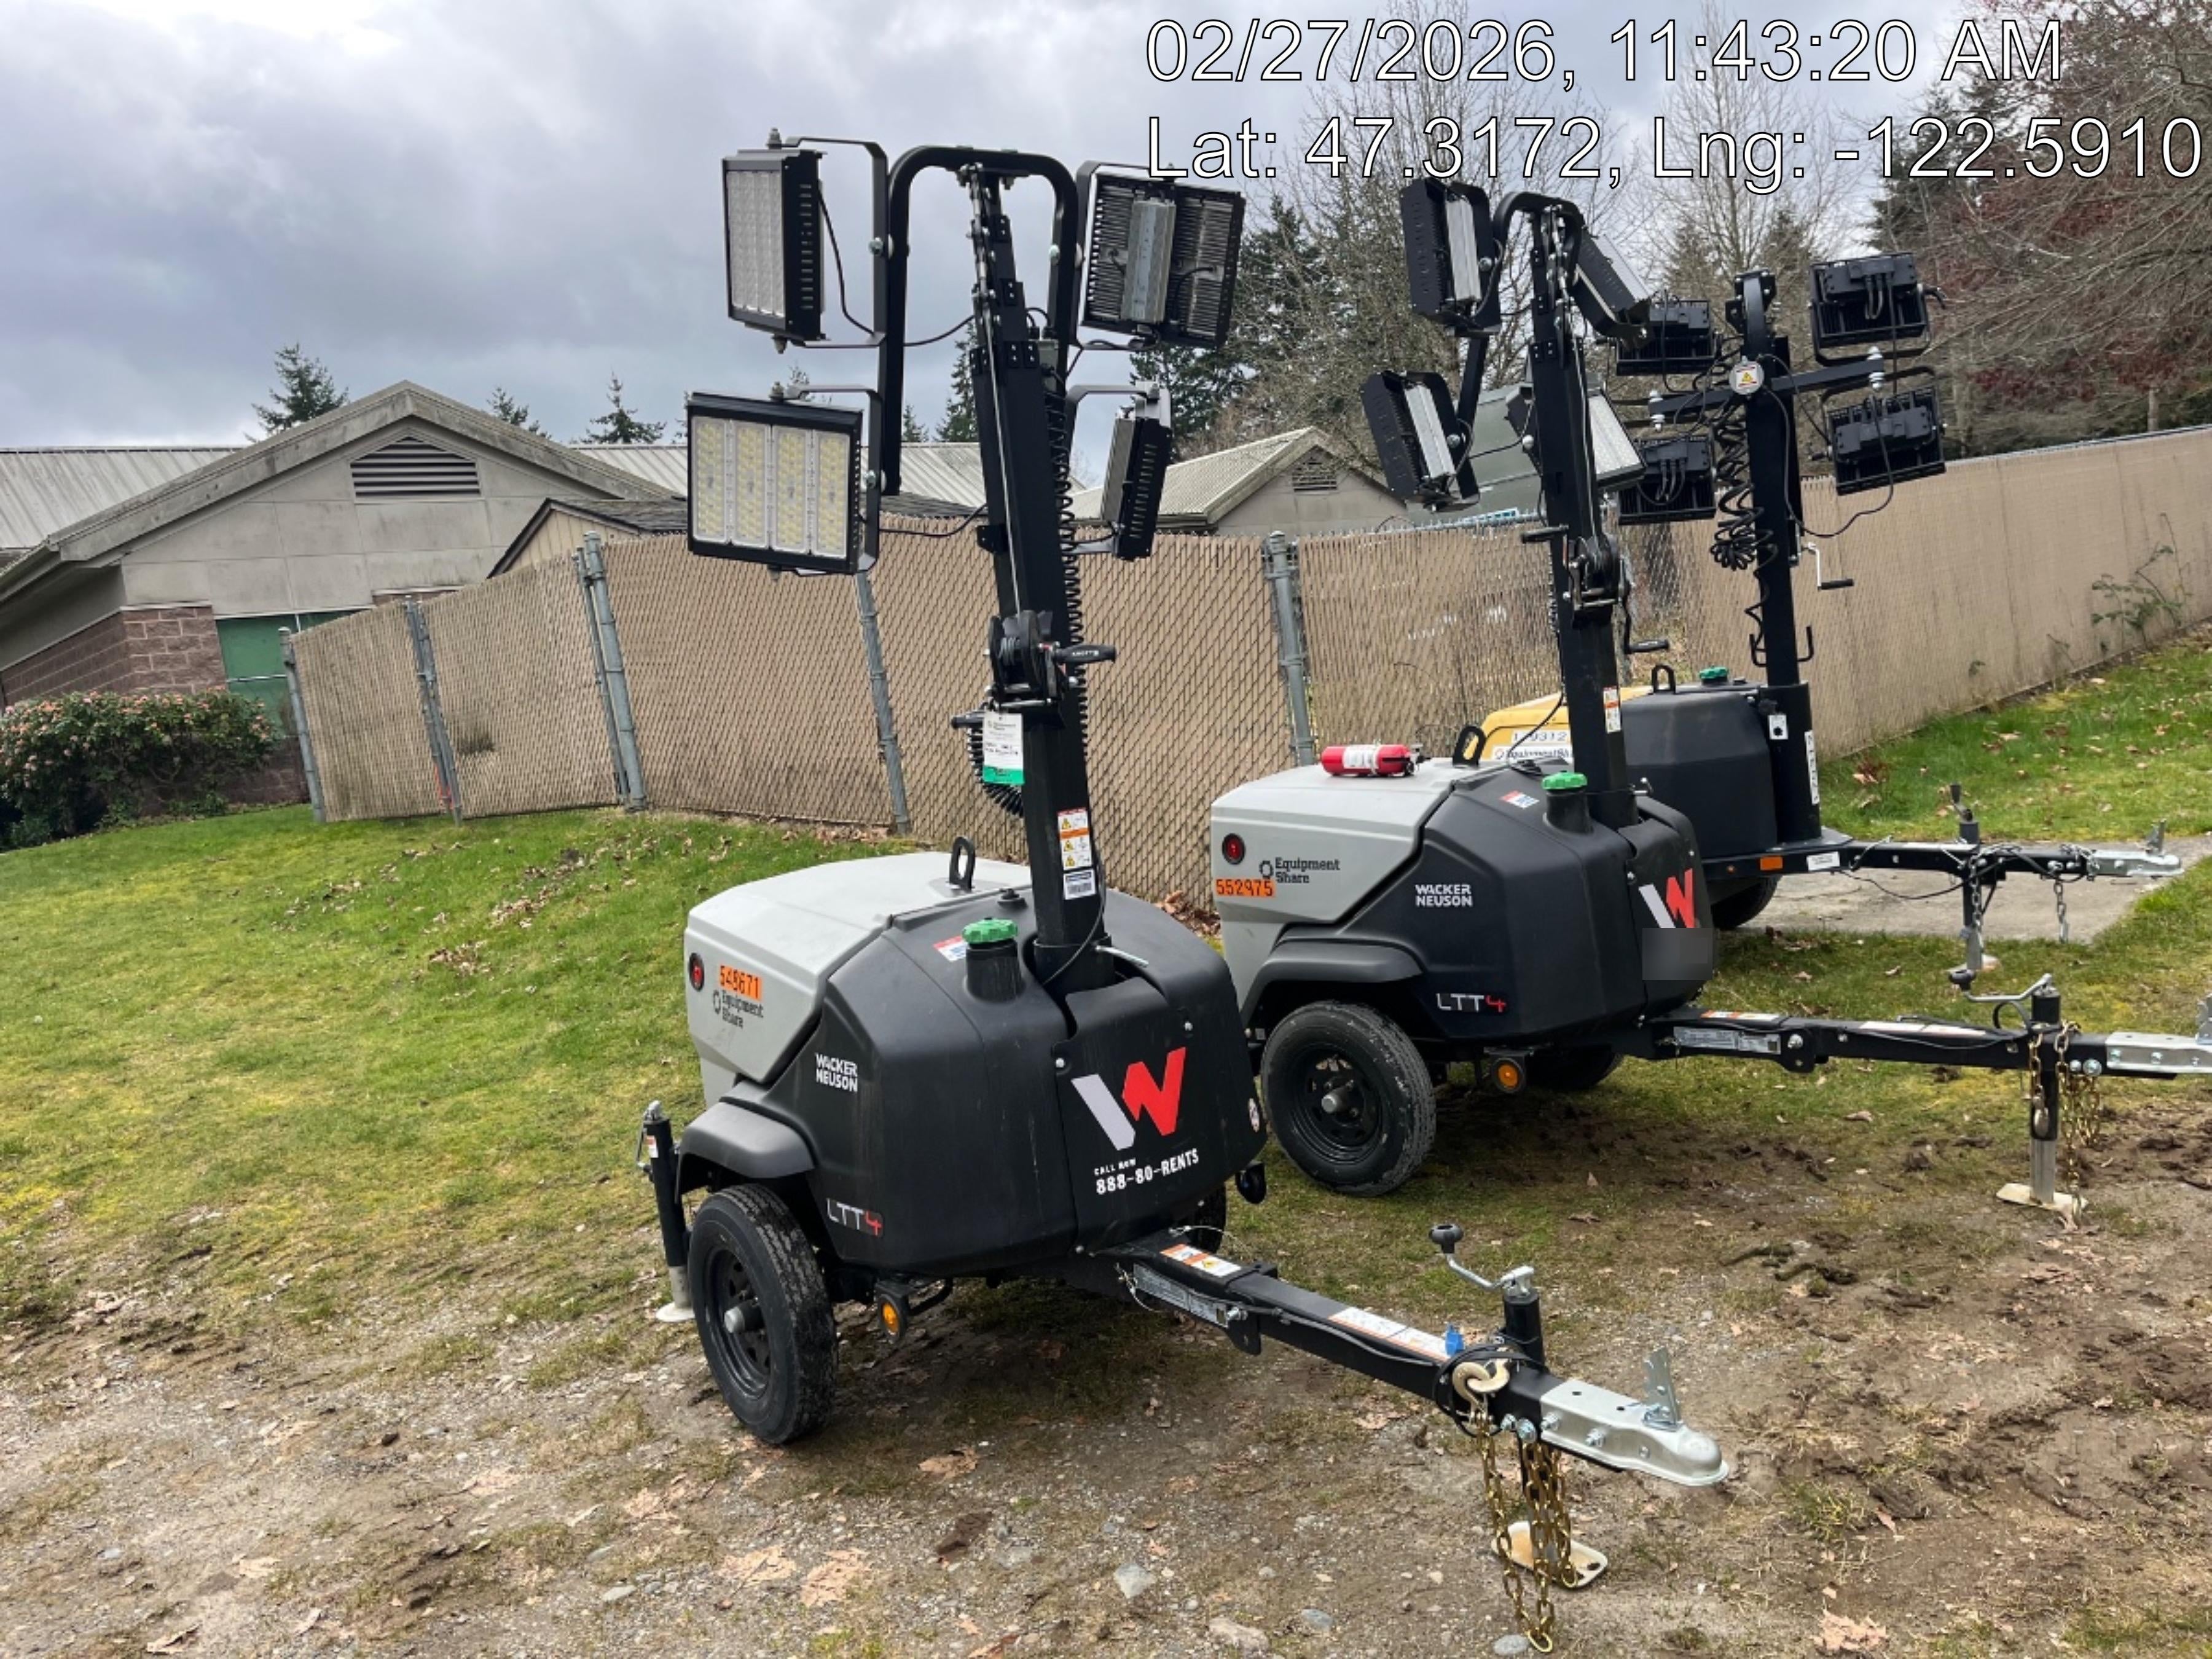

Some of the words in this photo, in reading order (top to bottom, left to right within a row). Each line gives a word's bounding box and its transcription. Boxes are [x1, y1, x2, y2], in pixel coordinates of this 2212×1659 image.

[1274, 857, 1341, 873] Equipment
[1275, 871, 1309, 884] Share
[1216, 879, 1273, 896] 552975
[1414, 884, 1472, 895] WACKER
[1415, 895, 1473, 908] NEUSON
[722, 989, 764, 1018] Equipment
[1435, 992, 1507, 1013] LTT4
[815, 1052, 858, 1078] WACKER
[815, 1068, 858, 1092] NEUSON
[1094, 1164, 1116, 1177] CALL
[1096, 1147, 1199, 1195] 888-80-RENTS
[826, 1198, 882, 1236] LTT4
